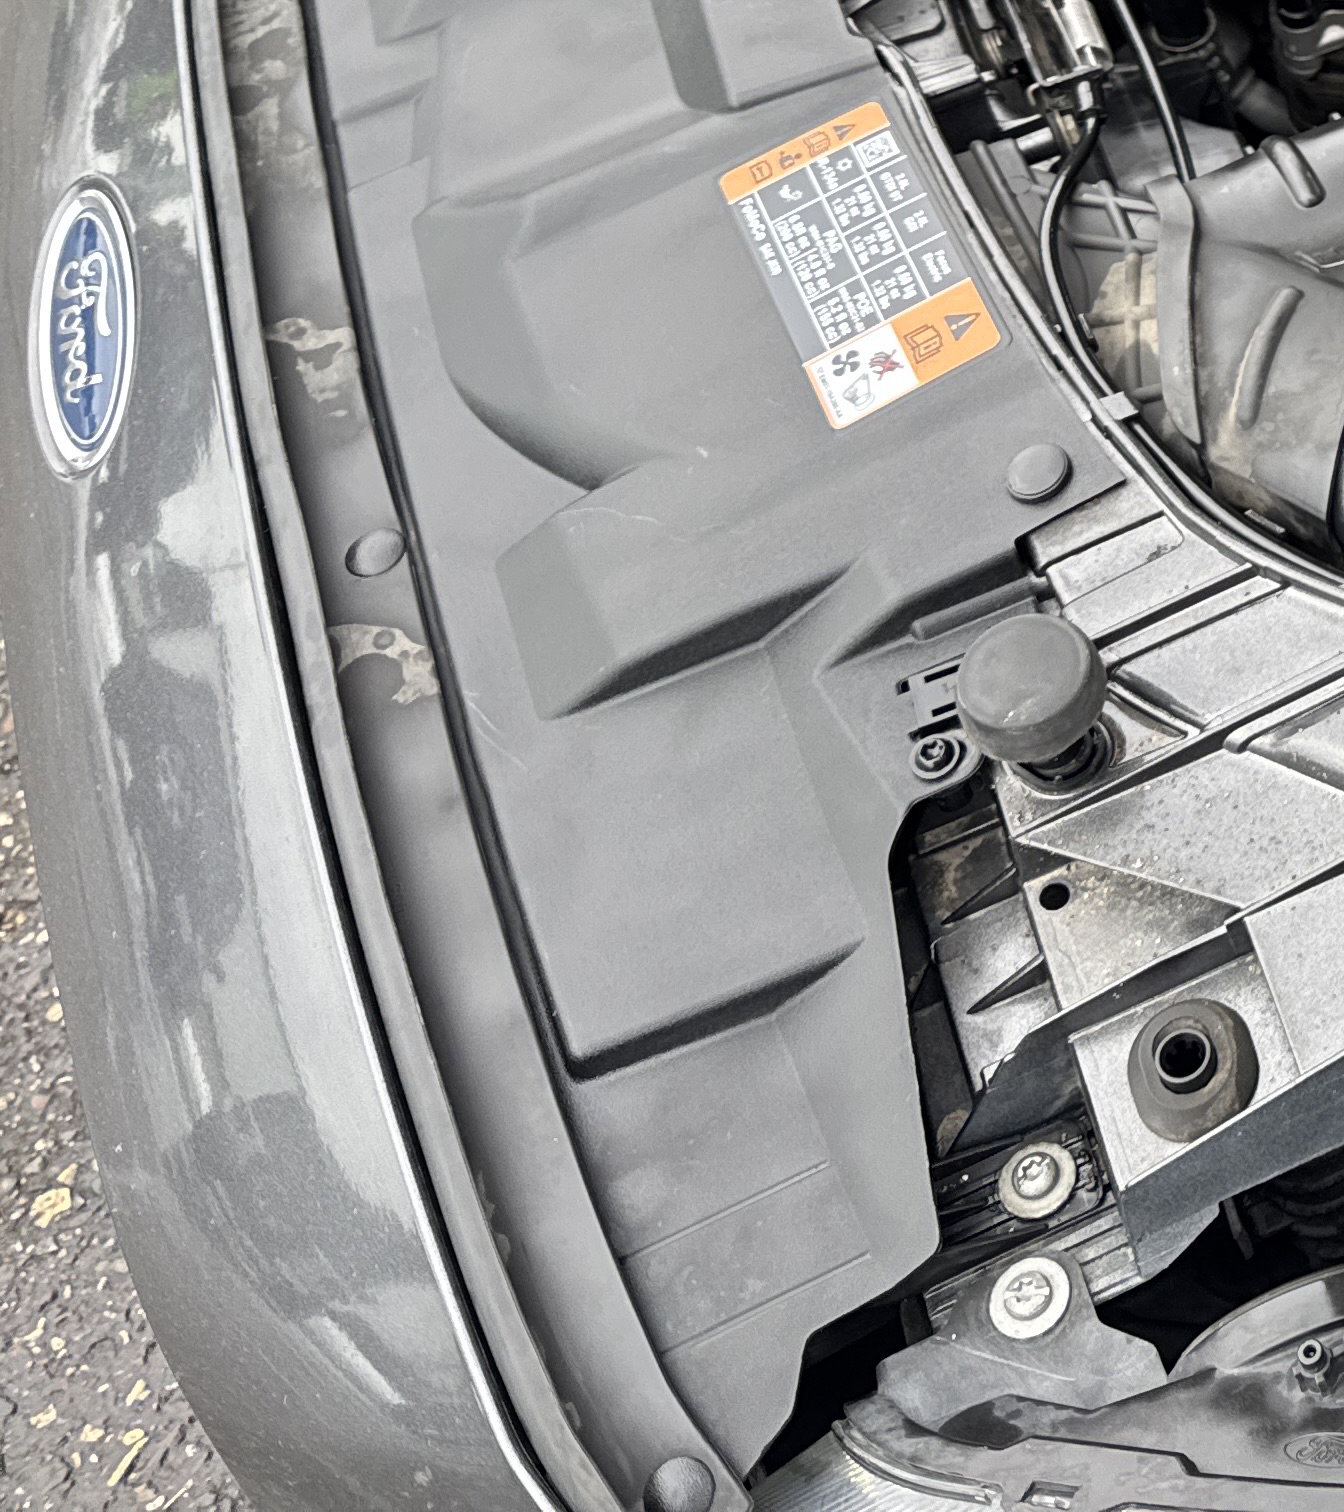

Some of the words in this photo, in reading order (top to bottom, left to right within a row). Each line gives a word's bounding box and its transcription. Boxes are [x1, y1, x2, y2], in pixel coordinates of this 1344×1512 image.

[822, 228, 843, 254] PAG
[851, 290, 874, 317] POE
[55, 250, 112, 405] Ford
